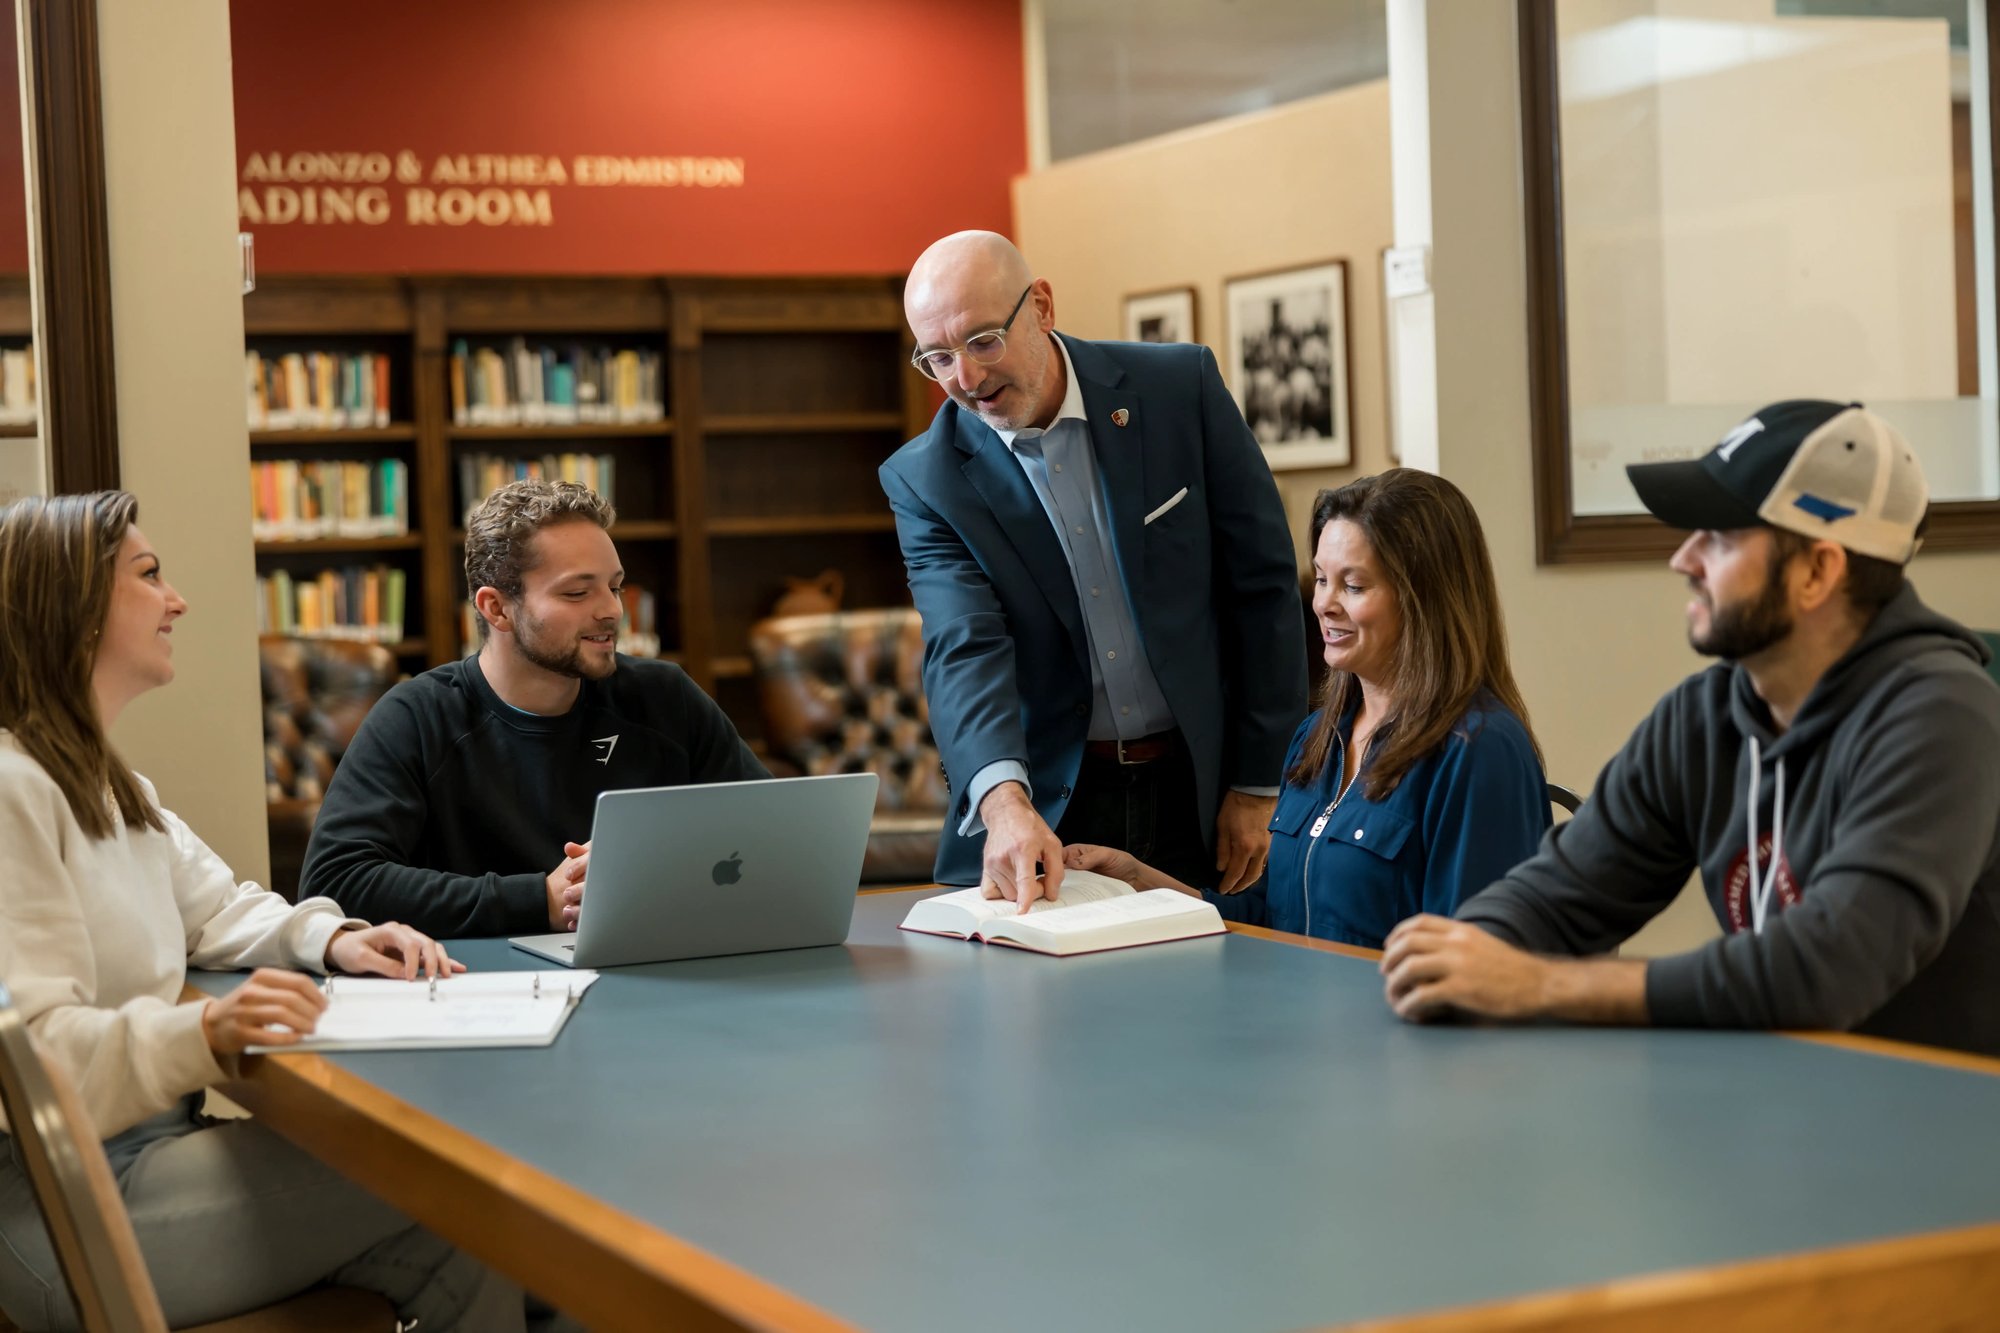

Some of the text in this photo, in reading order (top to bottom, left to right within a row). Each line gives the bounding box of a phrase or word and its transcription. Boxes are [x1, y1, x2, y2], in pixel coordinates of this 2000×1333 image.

[242, 148, 745, 188] ALONZO & ALTHEA EDMISTON
[406, 187, 553, 226] ROOM
